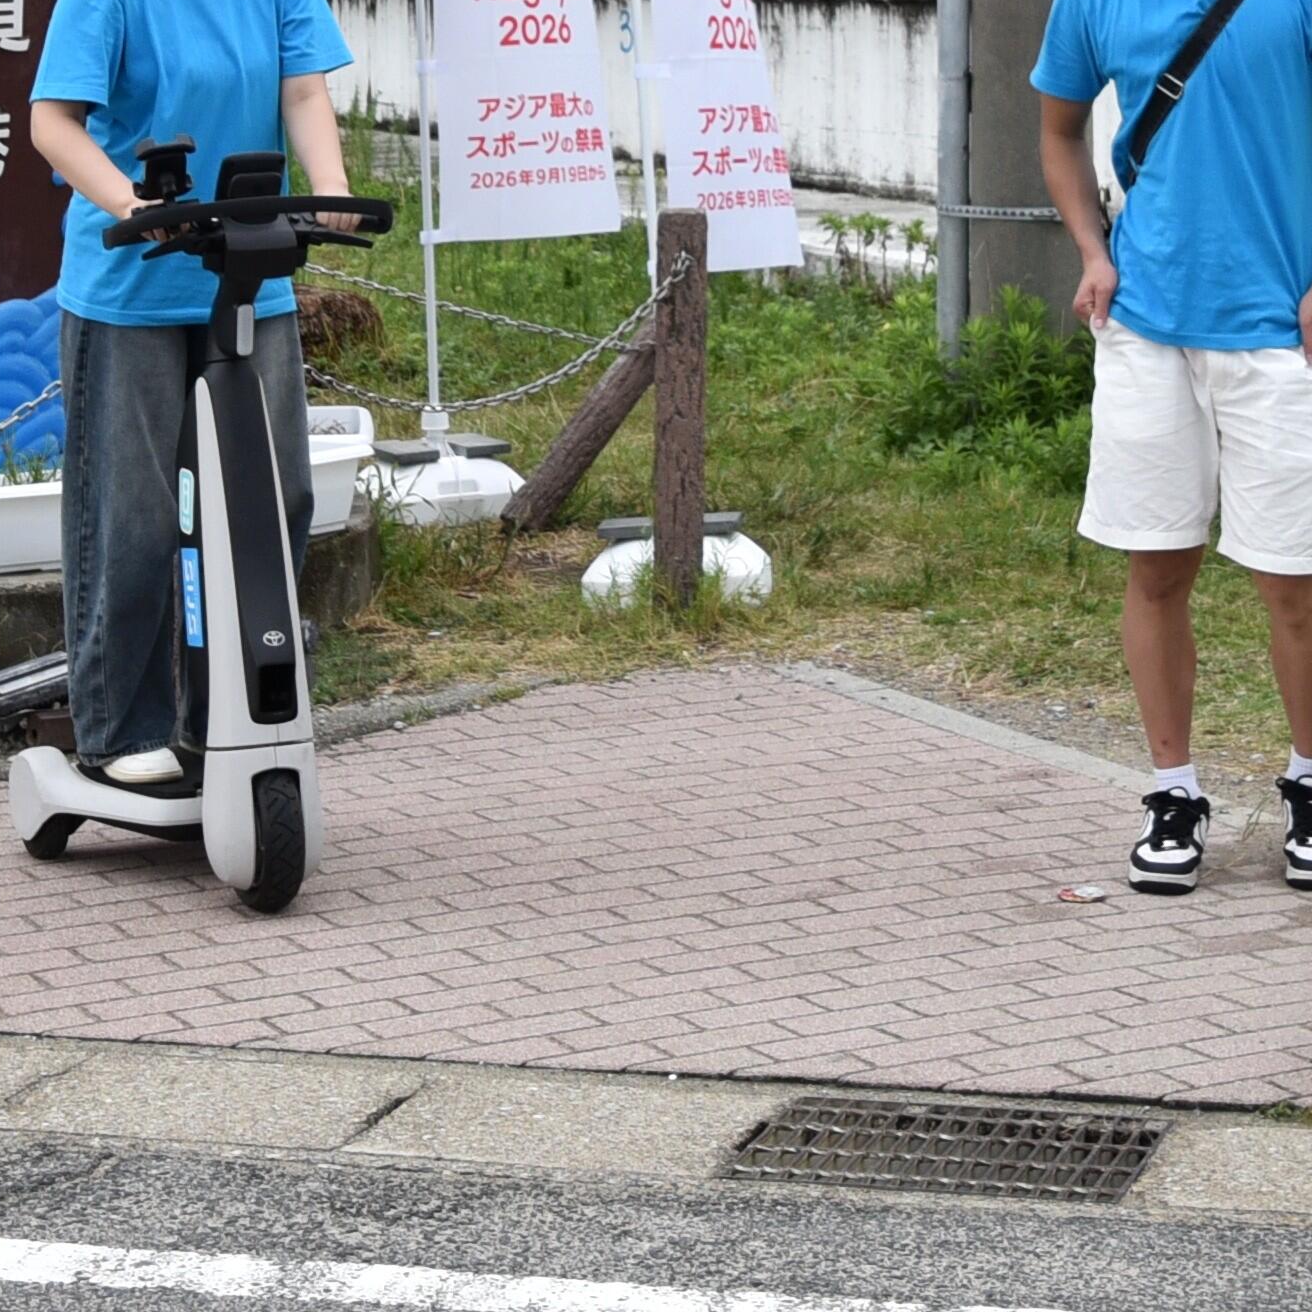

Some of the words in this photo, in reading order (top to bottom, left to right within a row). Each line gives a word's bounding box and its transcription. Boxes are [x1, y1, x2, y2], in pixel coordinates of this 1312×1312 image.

[499, 13, 572, 46] 2026
[707, 15, 757, 51] 2026
[477, 91, 594, 122] アジア最大の
[466, 127, 605, 159] スポーツの祭典
[469, 164, 607, 190] 2026年9月19日から
